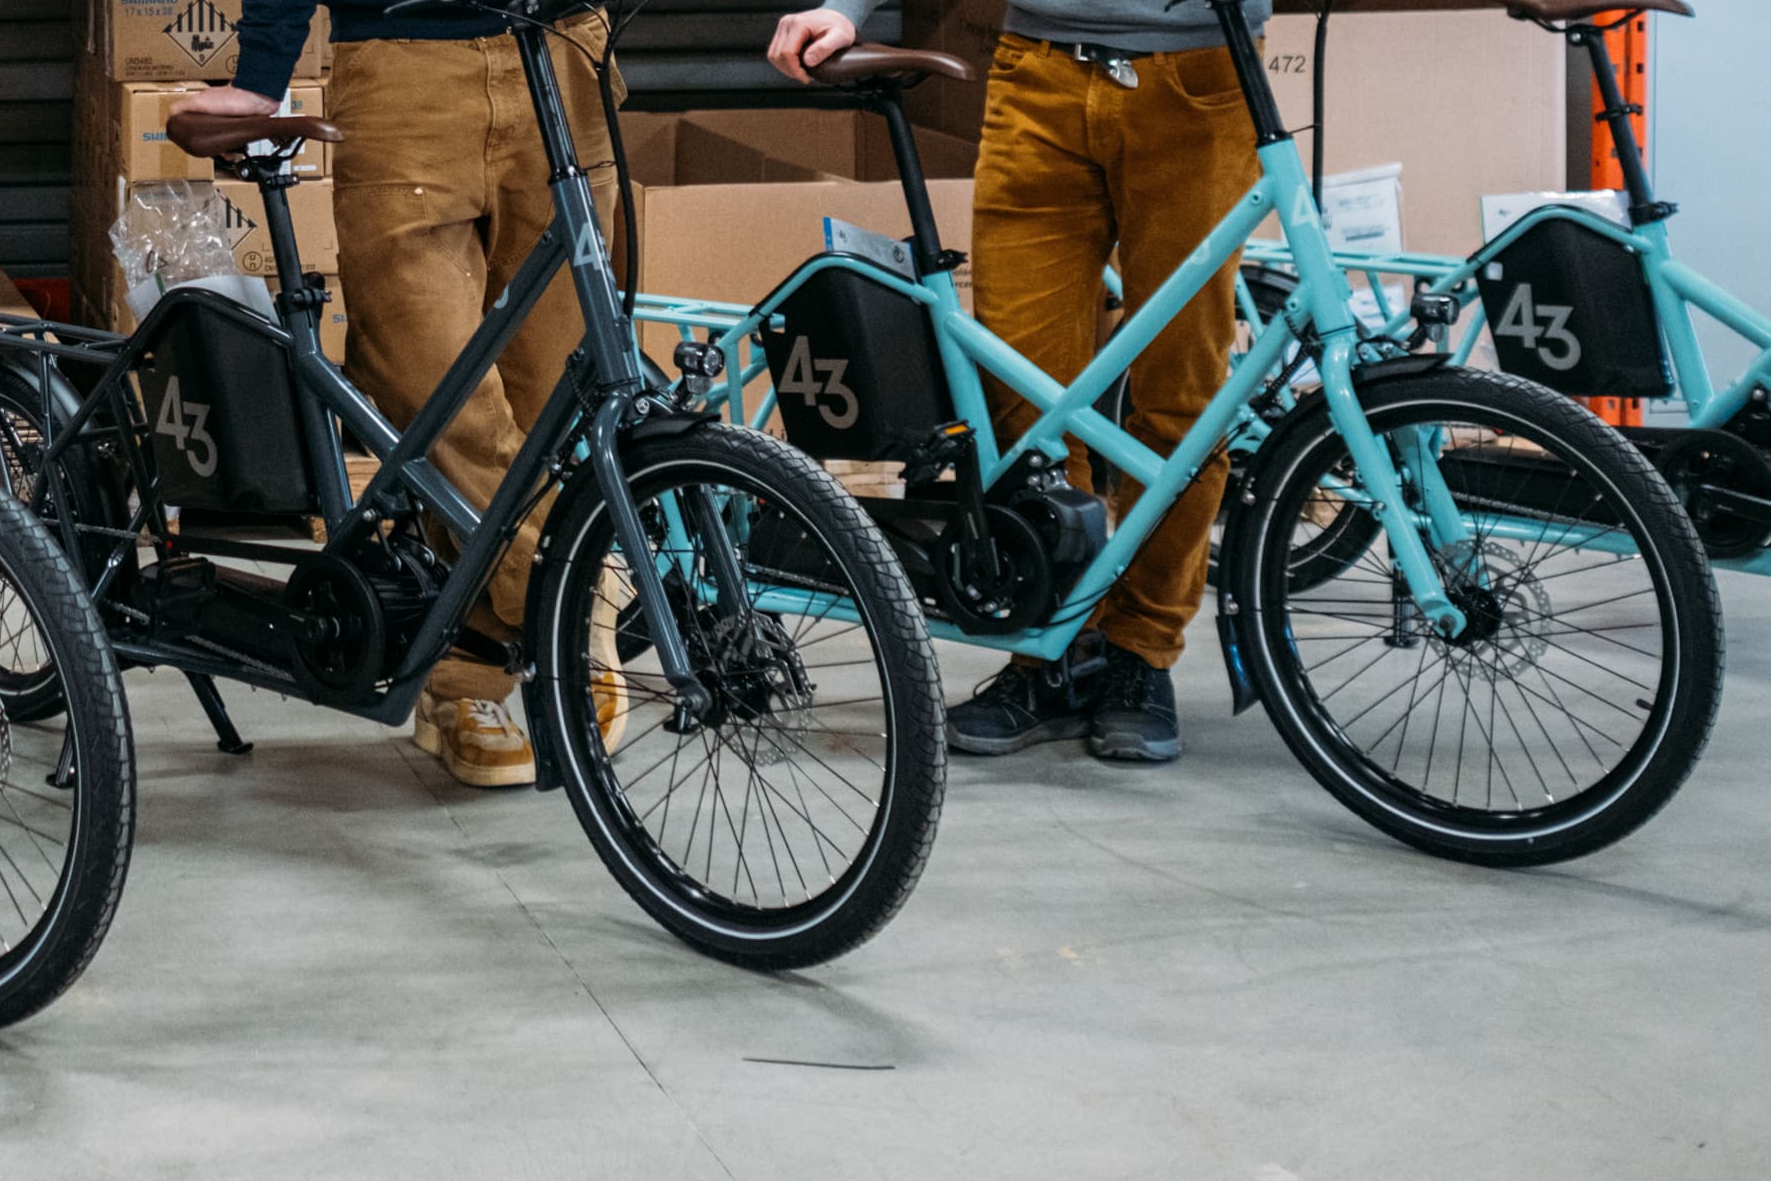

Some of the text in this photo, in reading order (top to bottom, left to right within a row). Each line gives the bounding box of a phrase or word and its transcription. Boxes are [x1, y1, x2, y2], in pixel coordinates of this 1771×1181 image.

[1269, 55, 1306, 74] 472
[1496, 283, 1582, 371] 43
[156, 376, 218, 477] 43
[779, 336, 858, 429] 43
